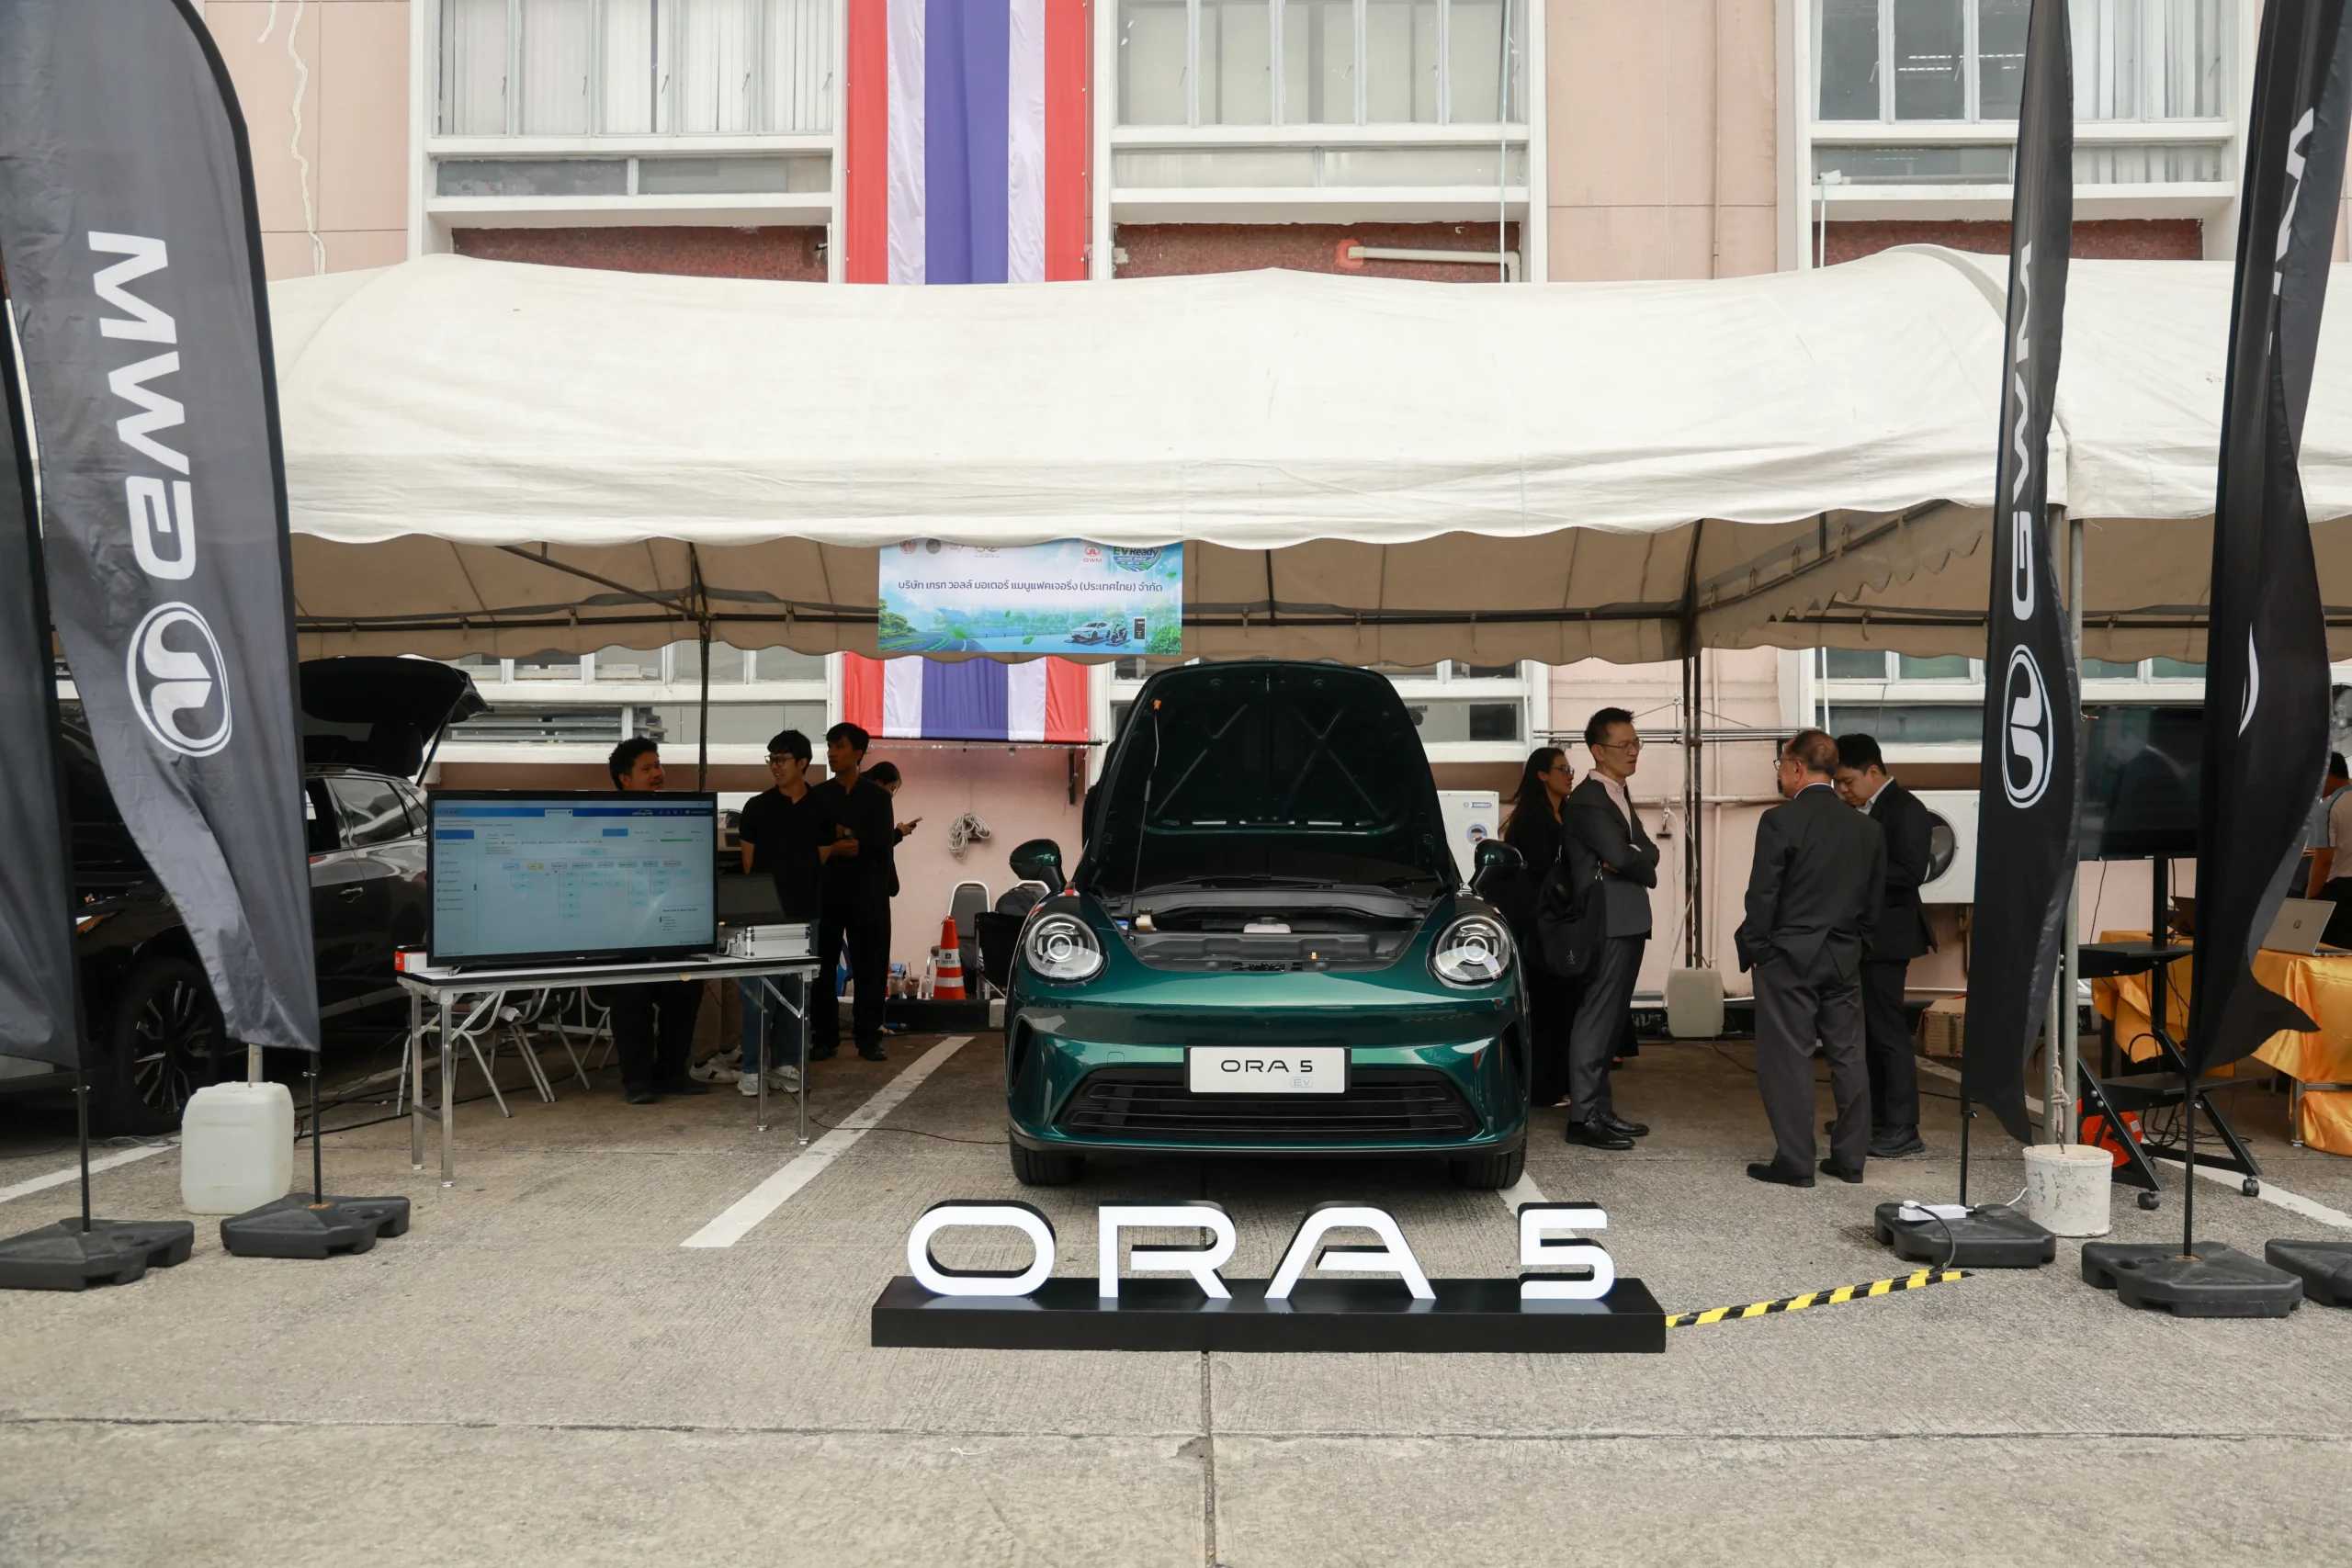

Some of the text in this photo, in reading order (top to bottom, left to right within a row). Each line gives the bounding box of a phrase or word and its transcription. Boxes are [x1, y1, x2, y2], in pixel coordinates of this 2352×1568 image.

[898, 579, 1163, 592] บริษัท เกรท วอลล์ มอเตอร์ แมนูแฟคเจอริ่ง (ประเทศไทย) จำกัด
[1221, 1060, 1313, 1073] ORA 5
[1293, 1078, 1311, 1087] EV
[907, 1201, 1615, 1301] ORA 5
